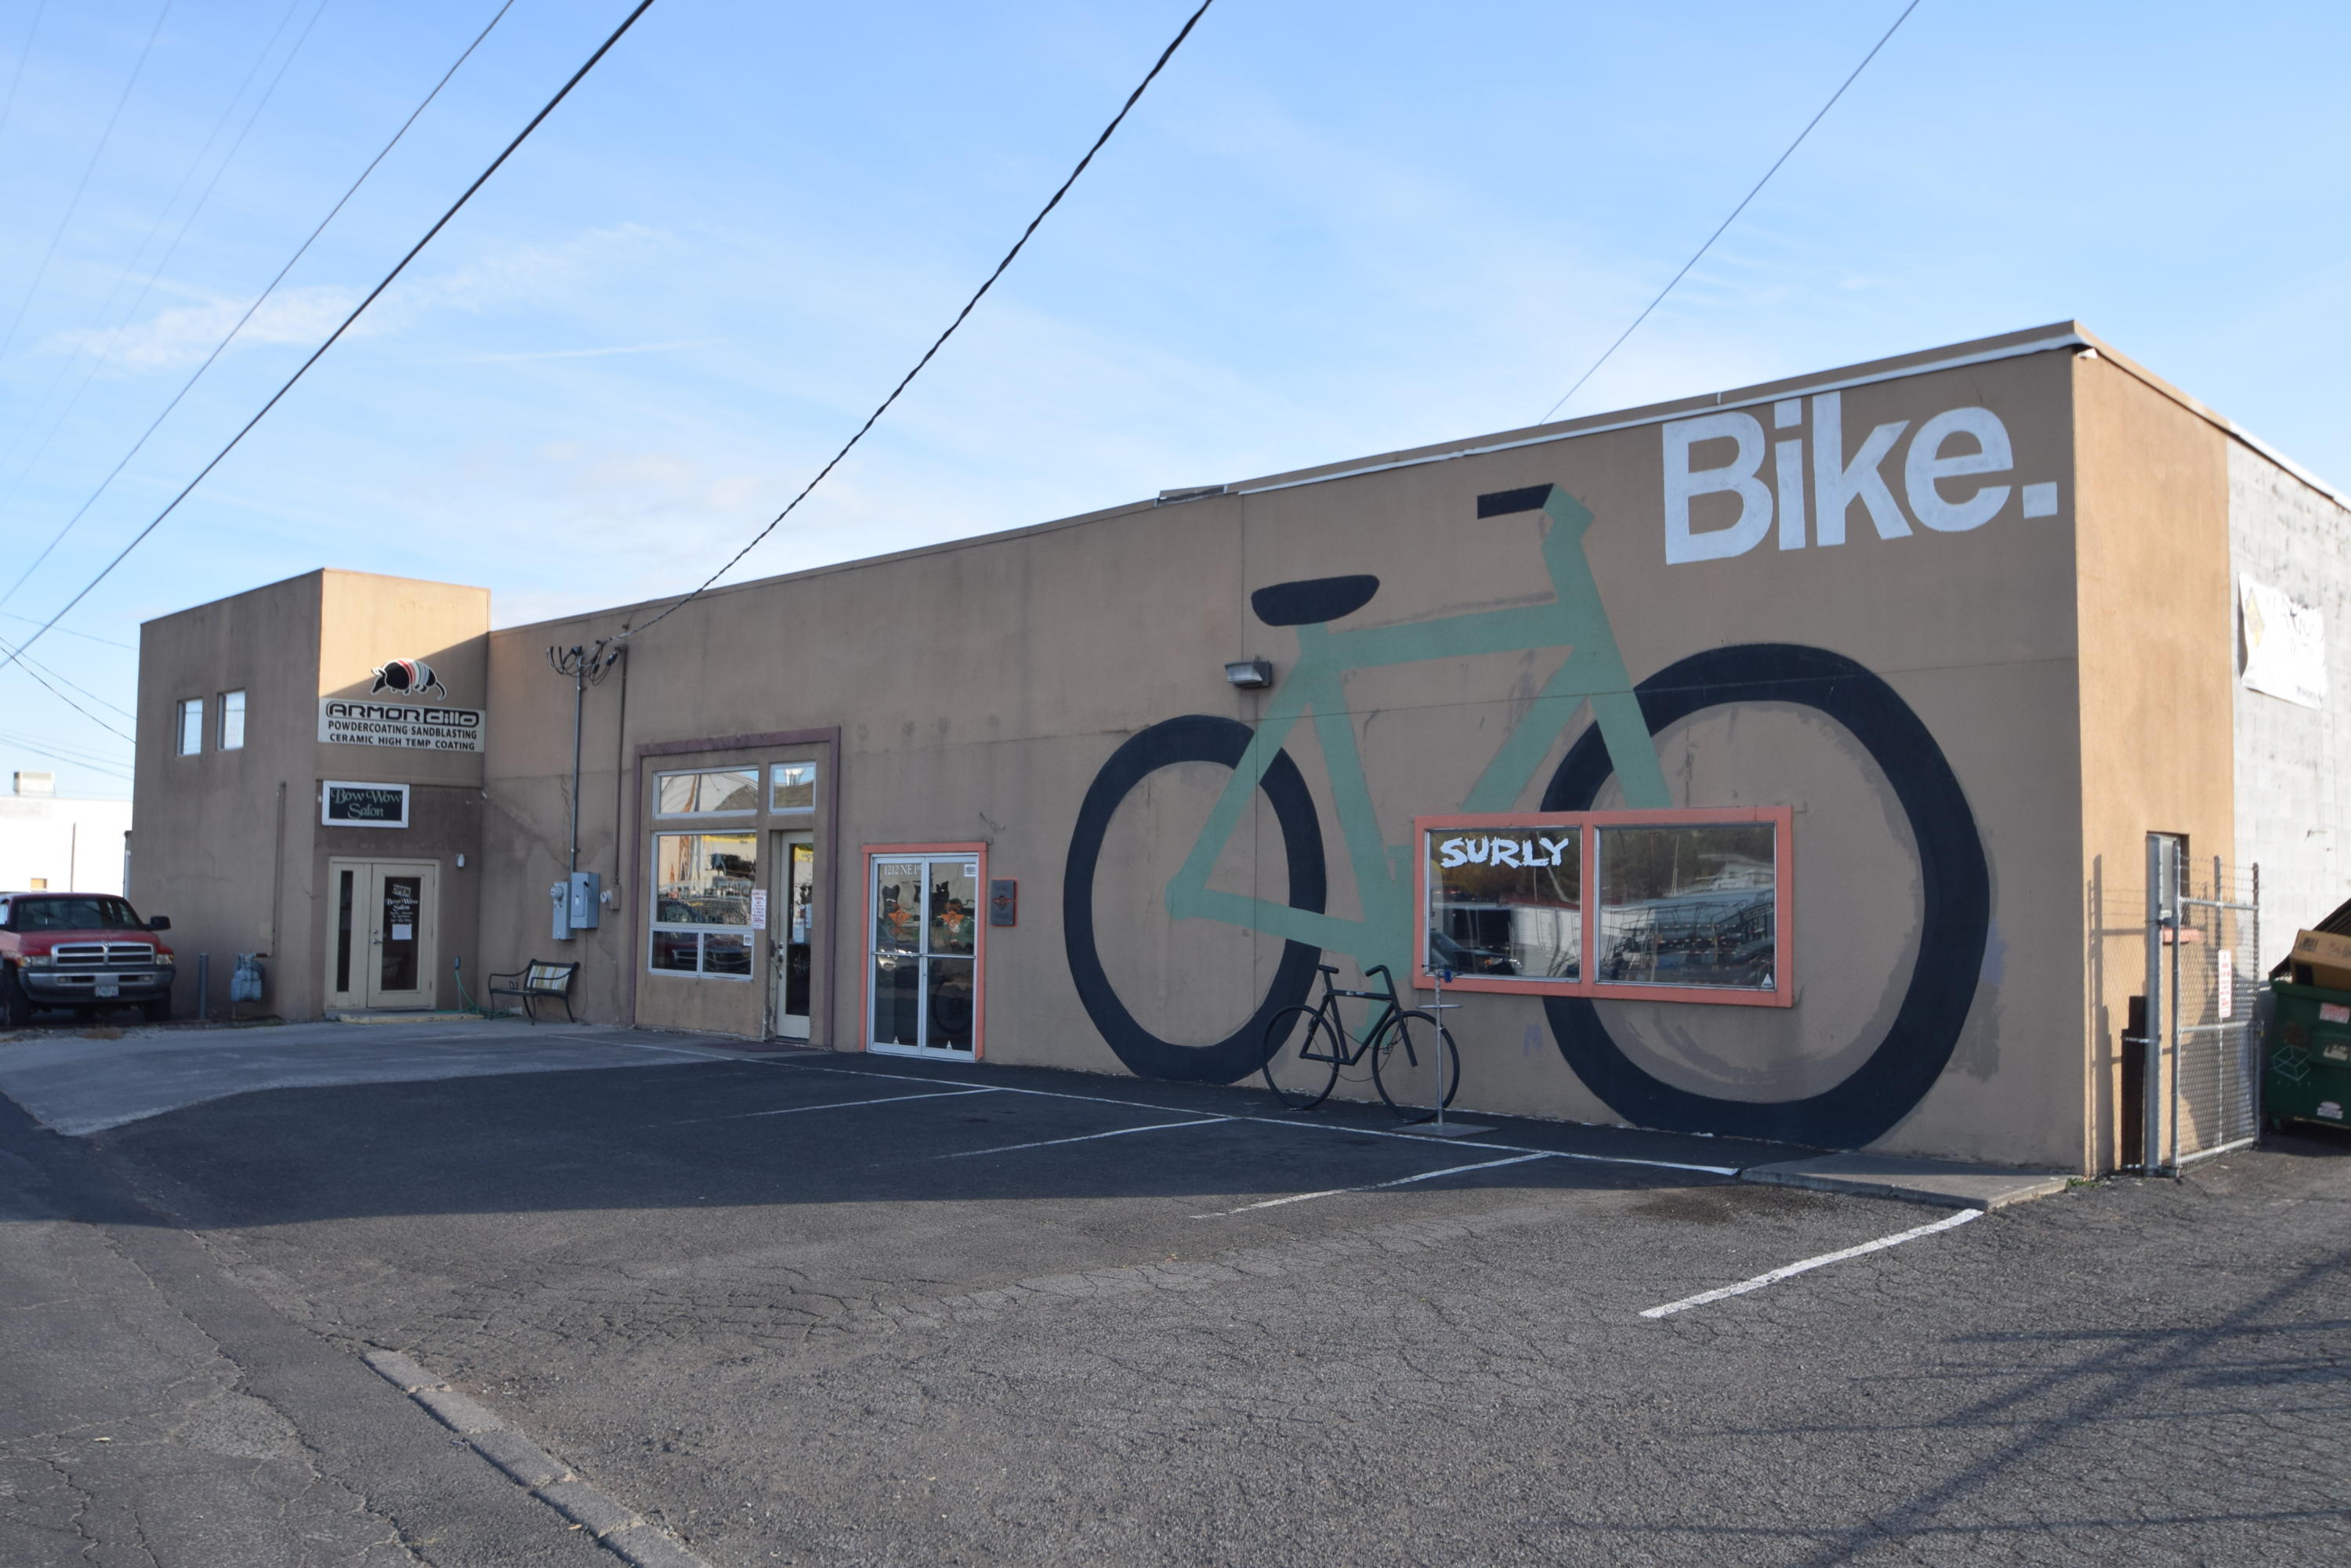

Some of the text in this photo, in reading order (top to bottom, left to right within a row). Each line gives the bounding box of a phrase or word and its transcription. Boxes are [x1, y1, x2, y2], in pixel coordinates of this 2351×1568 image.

[1662, 391, 2058, 565] Bike.
[330, 733, 475, 750] CERAMIC HIGH TEMP COATING
[331, 788, 402, 804] Bow Wow
[347, 802, 384, 819] Salon
[1440, 836, 1570, 869] SURLY
[884, 865, 900, 875] 1212
[900, 865, 912, 875] NE
